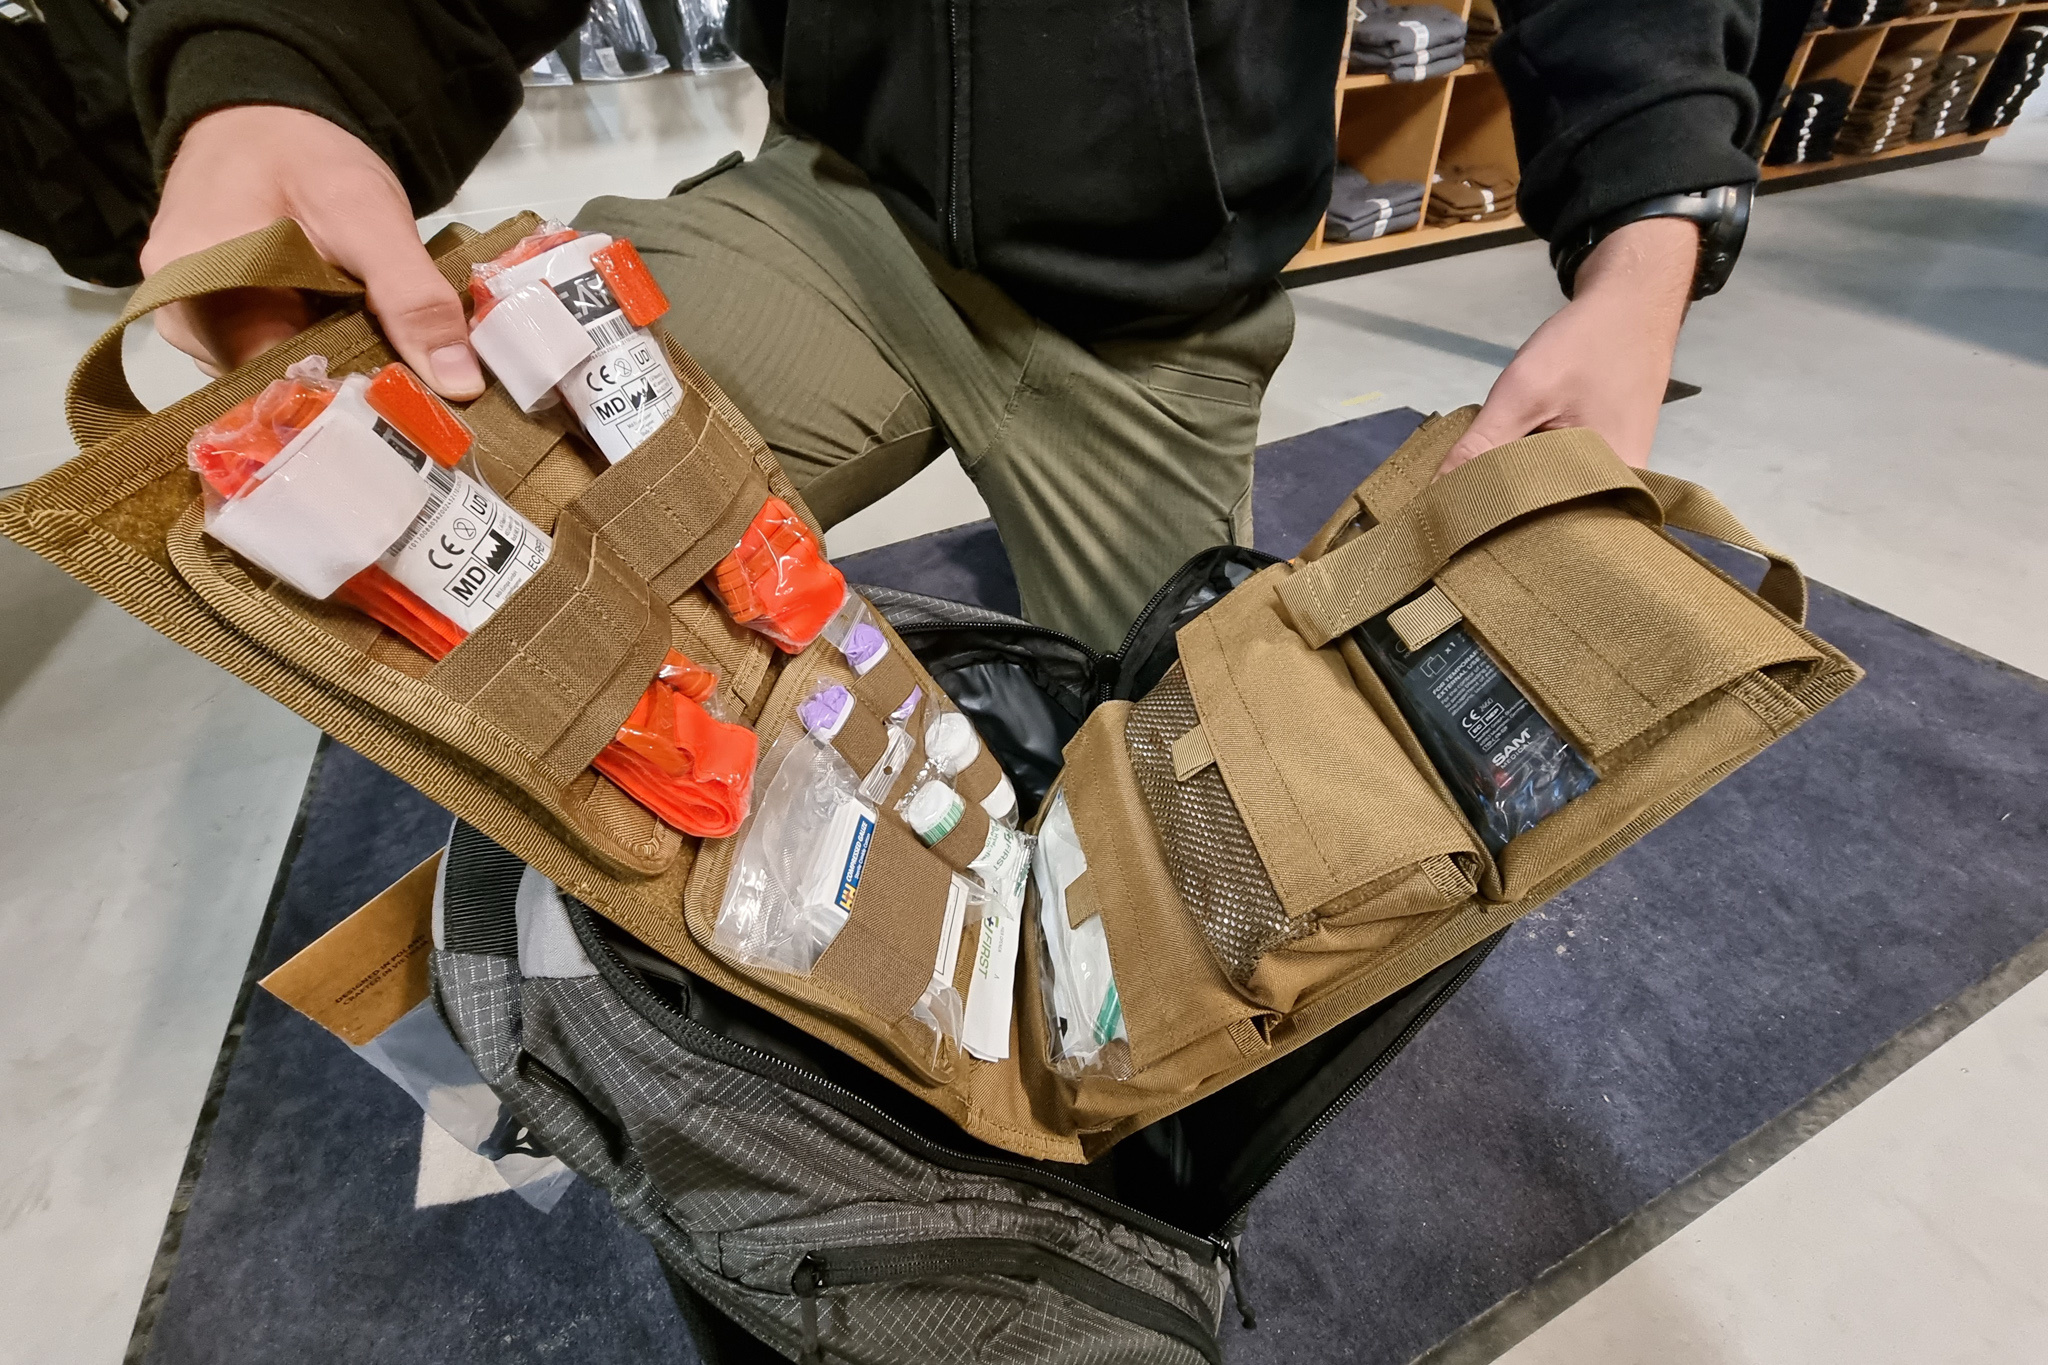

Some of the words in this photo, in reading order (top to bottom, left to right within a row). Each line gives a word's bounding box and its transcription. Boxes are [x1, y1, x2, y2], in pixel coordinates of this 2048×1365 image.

[596, 395, 626, 420] MD
[527, 553, 541, 570] EC
[451, 565, 486, 600] MD
[1431, 681, 1445, 694] FOR
[1435, 670, 1467, 699] EXTERNAL
[1466, 656, 1480, 669] USE
[1461, 709, 1480, 727] CE
[1472, 723, 1482, 733] EC
[1491, 729, 1531, 767] SAM
[1500, 741, 1532, 769] MEDICAL
[845, 841, 861, 881] COMPRESSED
[857, 820, 867, 841] GAUZE
[993, 843, 1011, 871] FIRST
[977, 932, 992, 979] FIRST
[334, 968, 380, 1003] DESIGNED
[380, 960, 390, 969] IN
[342, 975, 381, 1005] CRAFTED
[381, 967, 392, 977] IN
